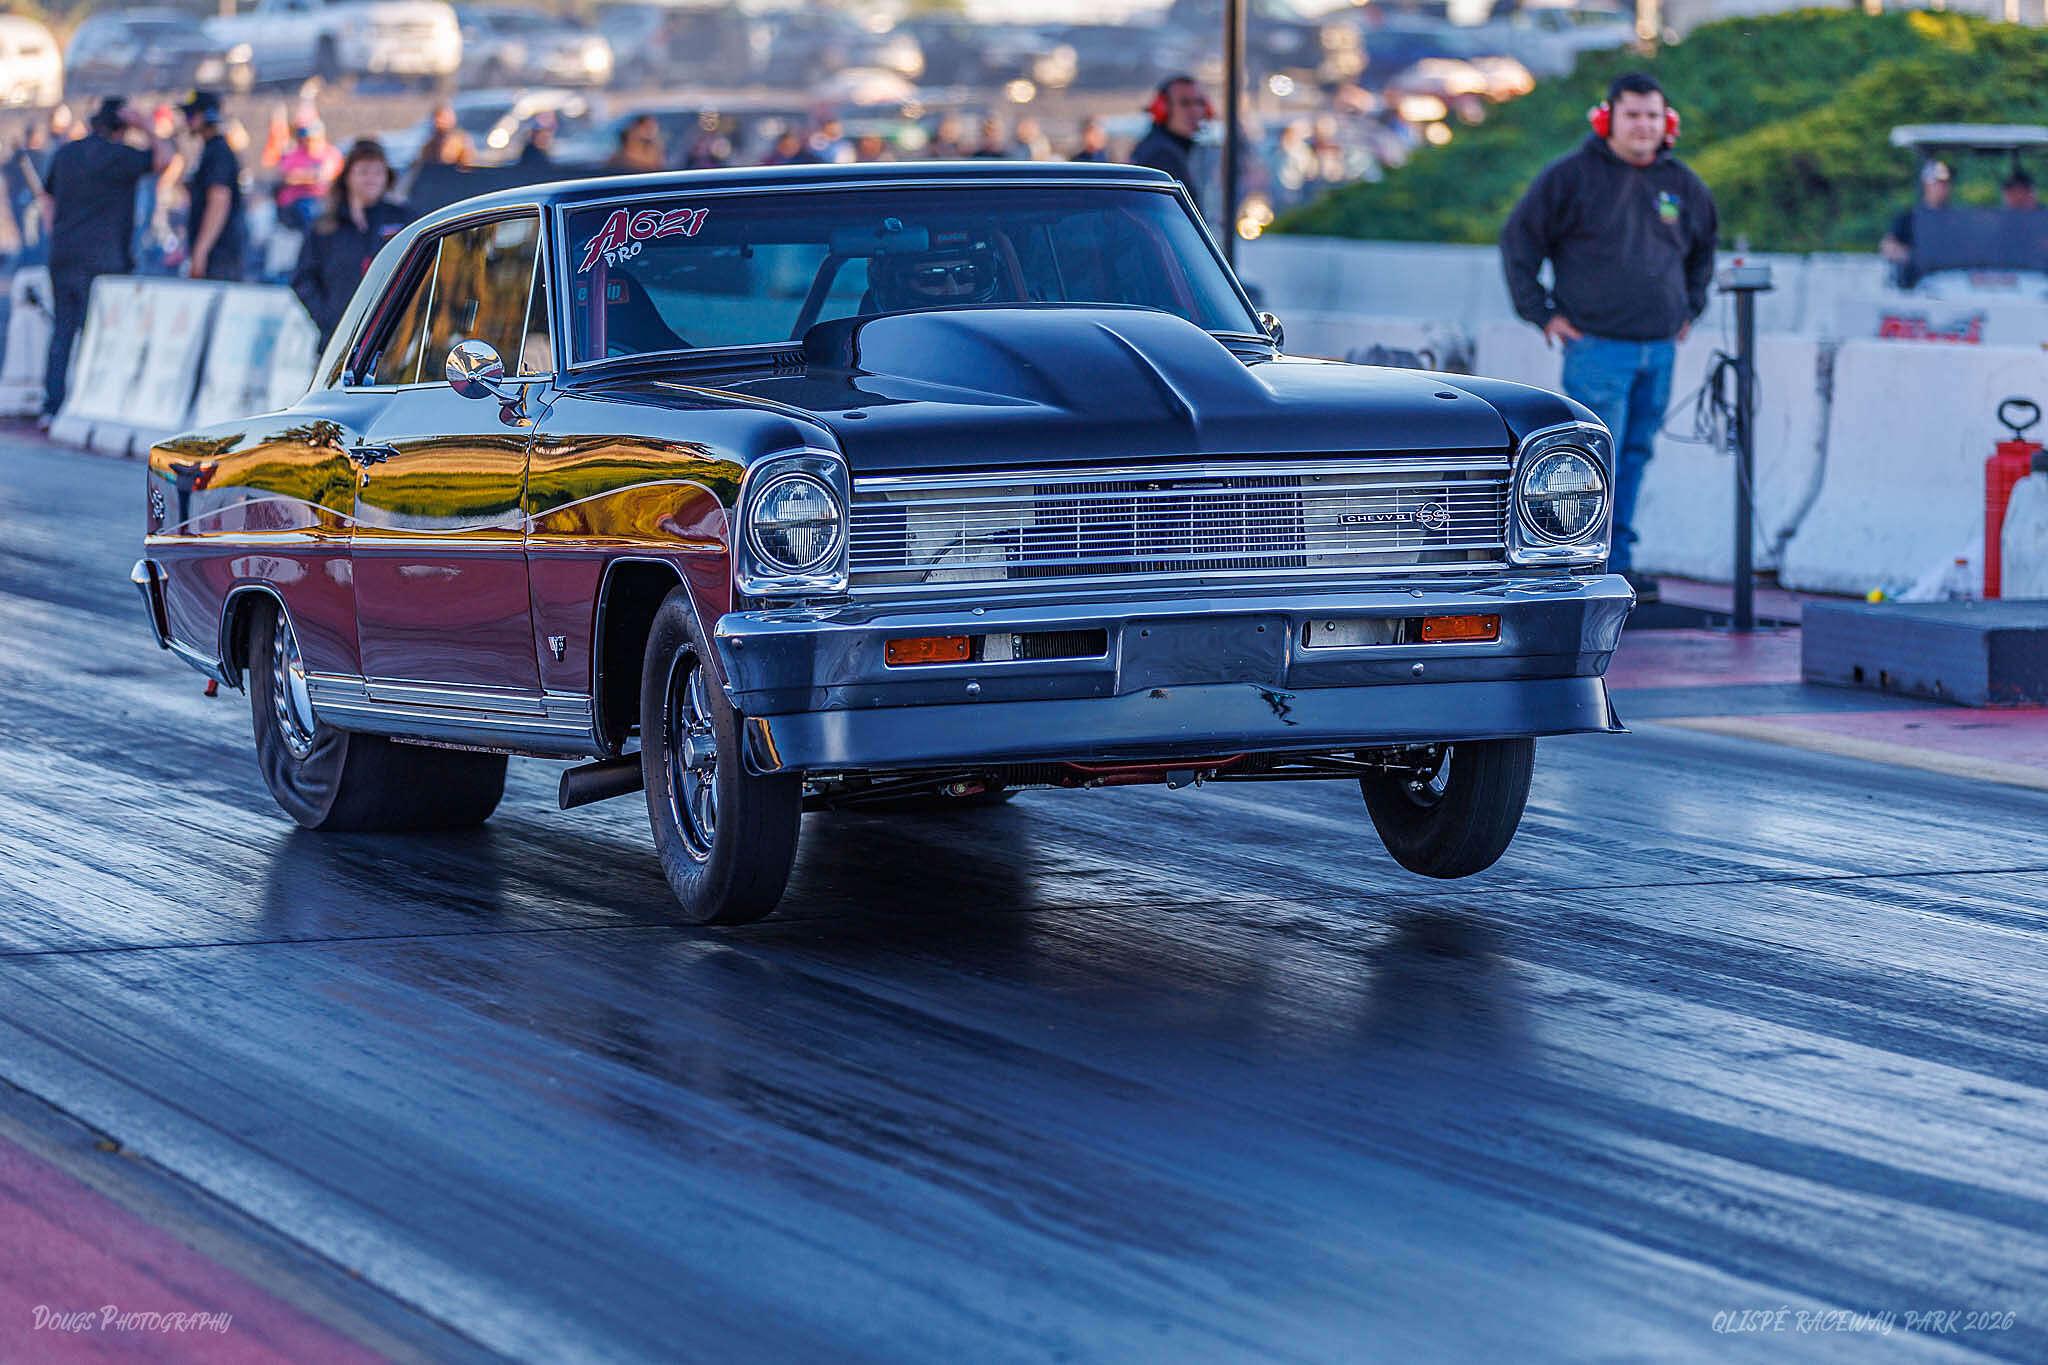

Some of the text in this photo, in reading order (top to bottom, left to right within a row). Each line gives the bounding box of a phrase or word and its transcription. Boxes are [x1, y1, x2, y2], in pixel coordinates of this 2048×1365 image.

[577, 207, 709, 274] A621
[603, 242, 642, 268] PRO
[1347, 514, 1393, 522] CHEVY
[1416, 509, 1450, 523] SS
